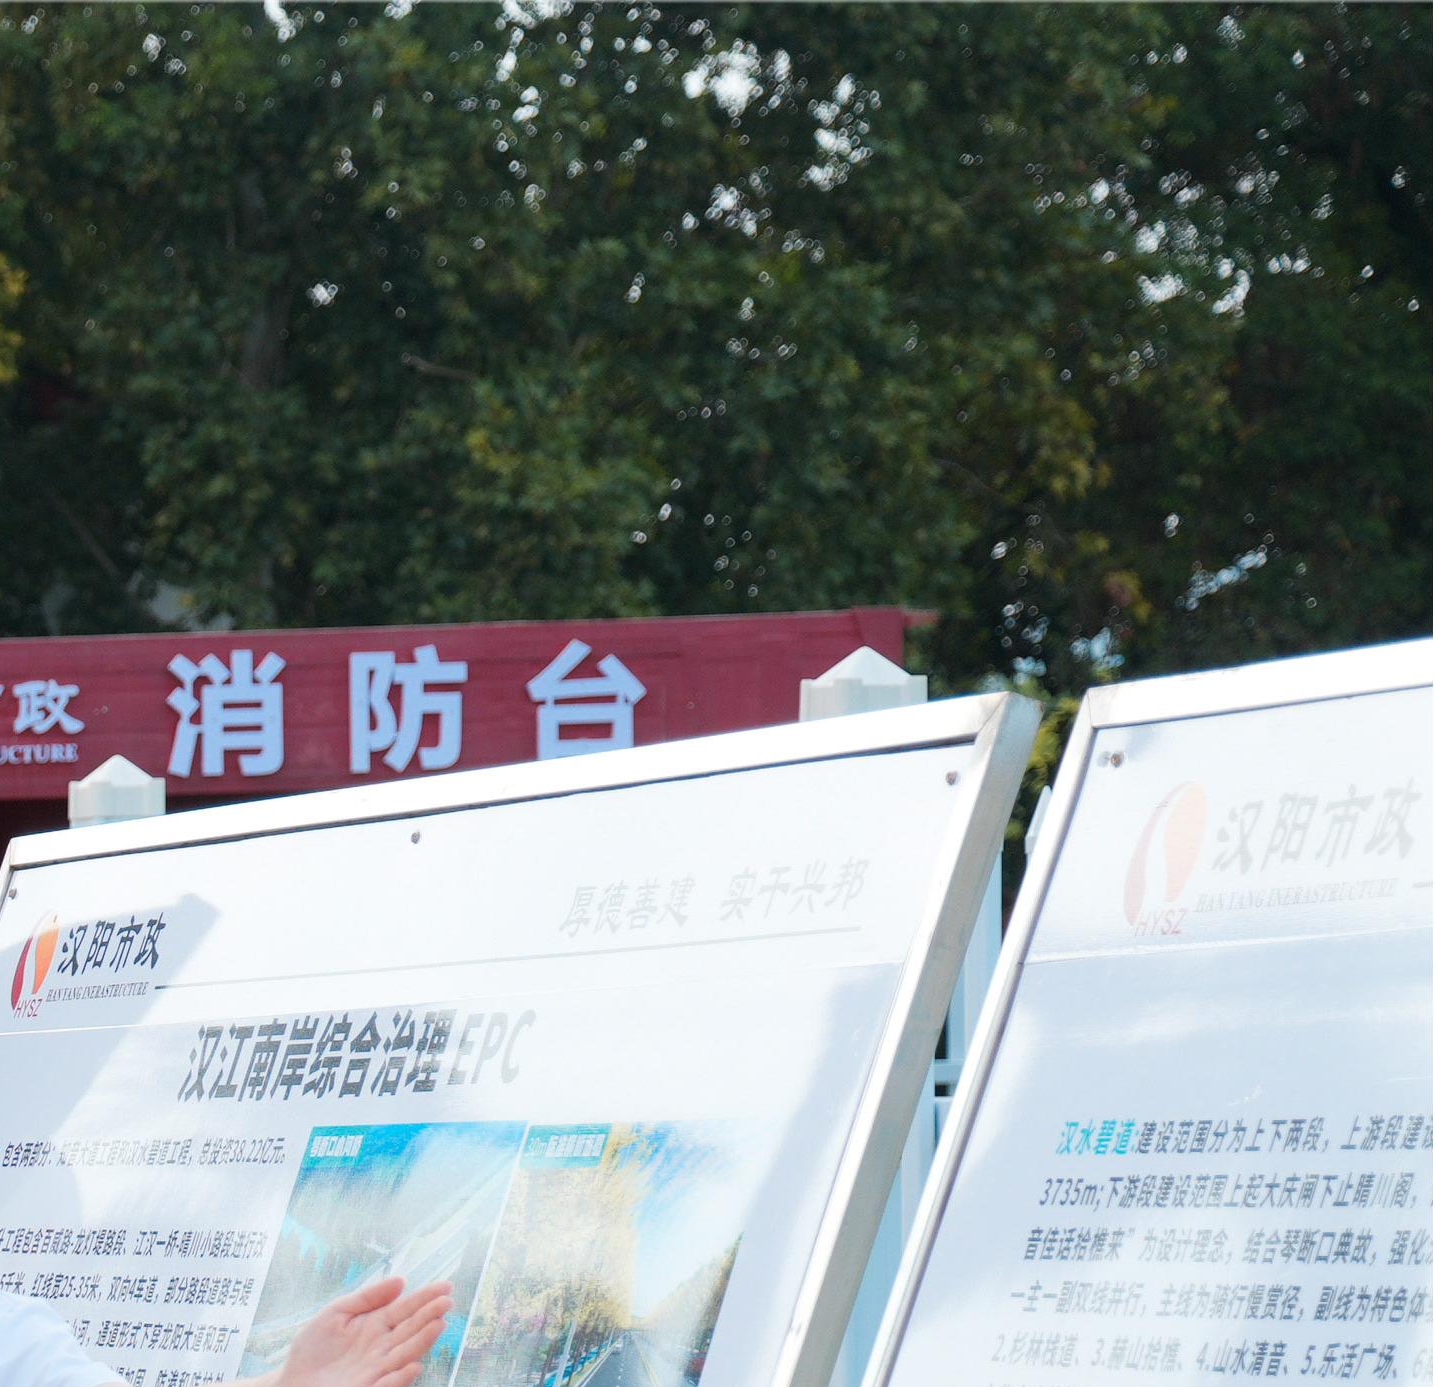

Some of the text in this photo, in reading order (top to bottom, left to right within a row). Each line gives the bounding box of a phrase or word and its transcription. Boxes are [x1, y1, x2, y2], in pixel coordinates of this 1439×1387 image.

[167, 638, 647, 778] 消防台
[1211, 776, 1423, 875] 汉阳市政
[57, 912, 166, 977] 汉阳市政
[14, 999, 43, 1018] HYSZ
